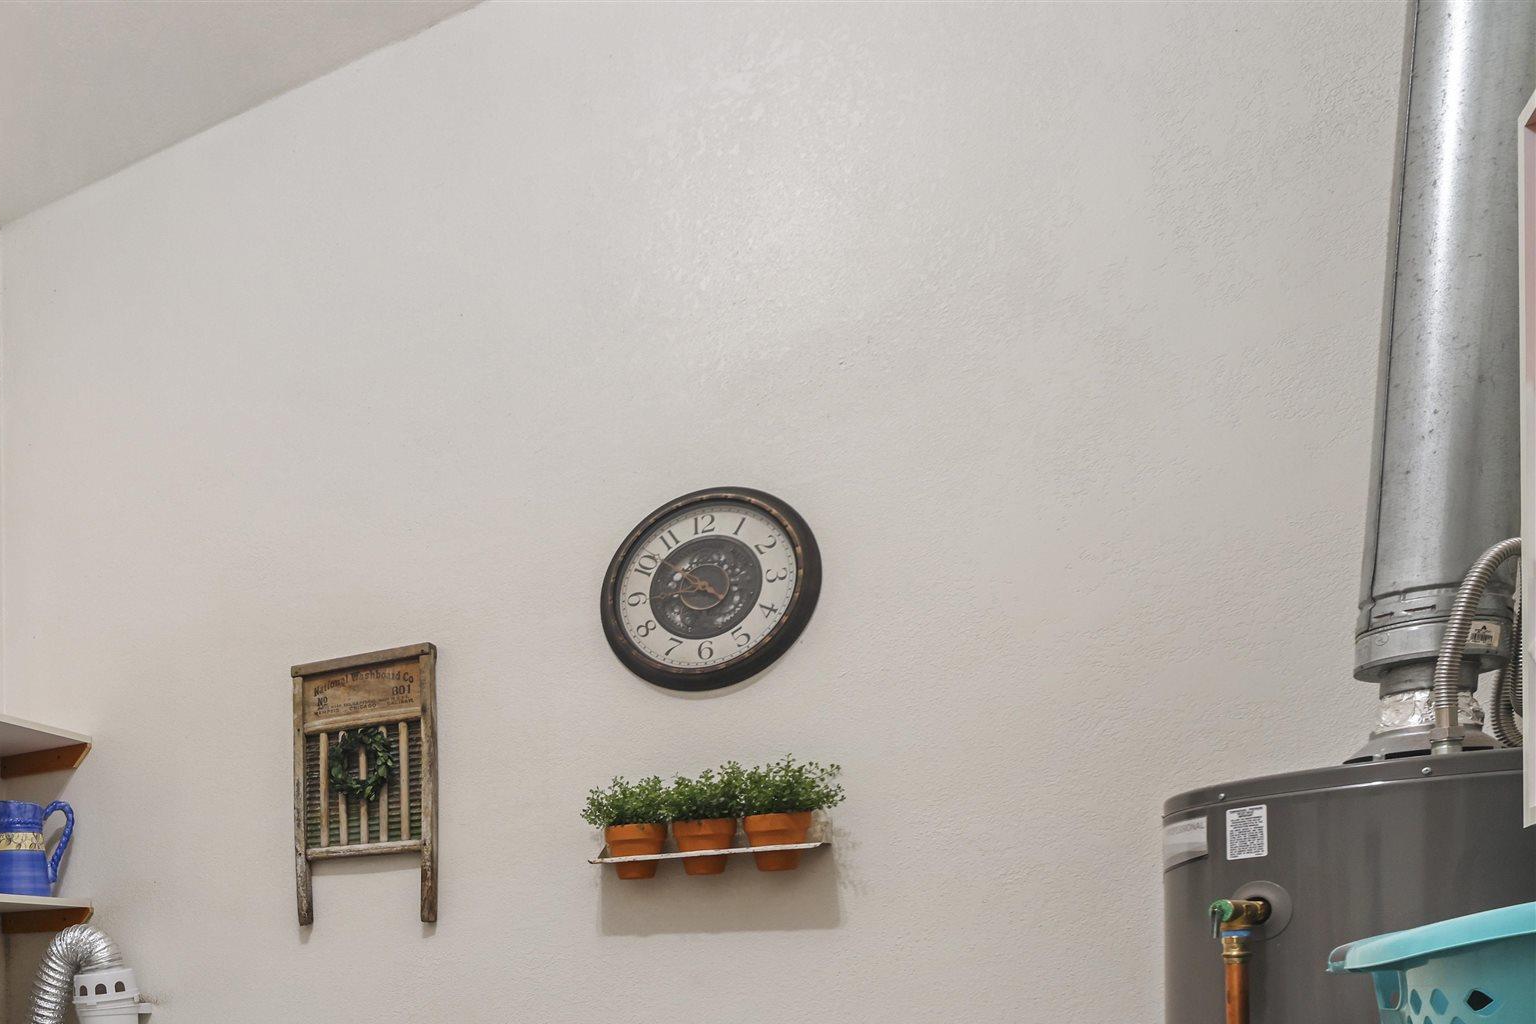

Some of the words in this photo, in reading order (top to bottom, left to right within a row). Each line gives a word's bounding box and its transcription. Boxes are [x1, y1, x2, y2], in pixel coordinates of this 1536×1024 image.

[693, 514, 716, 535] 12
[733, 517, 746, 536] 1
[659, 529, 681, 551] 11
[754, 534, 777, 555] 2
[634, 553, 659, 577] 10
[765, 567, 788, 583] 3
[627, 591, 648, 607] 9
[759, 602, 779, 618] 4
[636, 619, 657, 638] 8
[731, 626, 752, 647] 5
[664, 637, 683, 657] 7
[697, 640, 714, 660] 6
[314, 674, 349, 697] National
[351, 669, 400, 682] Washboard
[403, 672, 414, 683] Co
[349, 703, 377, 711] CHICAGO
